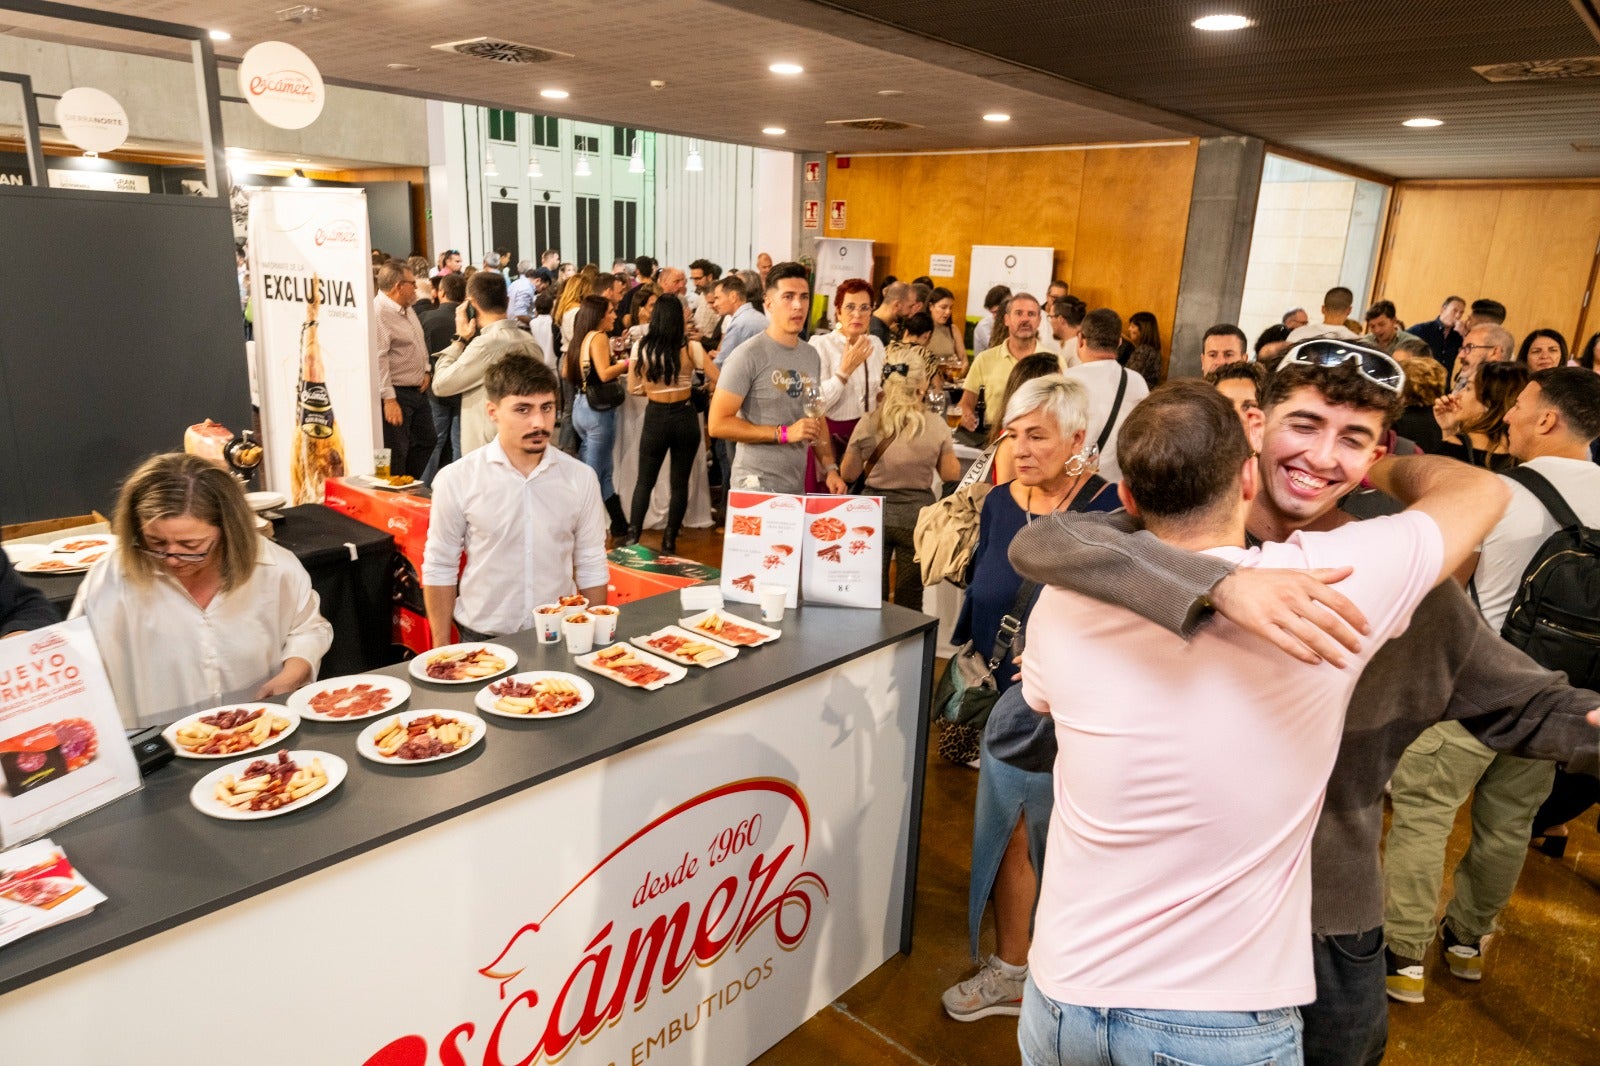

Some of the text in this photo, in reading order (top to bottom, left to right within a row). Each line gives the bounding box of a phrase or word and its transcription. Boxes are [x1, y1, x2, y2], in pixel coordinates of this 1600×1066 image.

[0, 173, 23, 186] AN
[264, 274, 357, 308] EXCLUSIVA
[0, 653, 65, 686] UEVO
[0, 666, 79, 702] RMATO
[632, 813, 762, 909] desde 1960
[631, 957, 774, 1066] EMBUTIDOS
